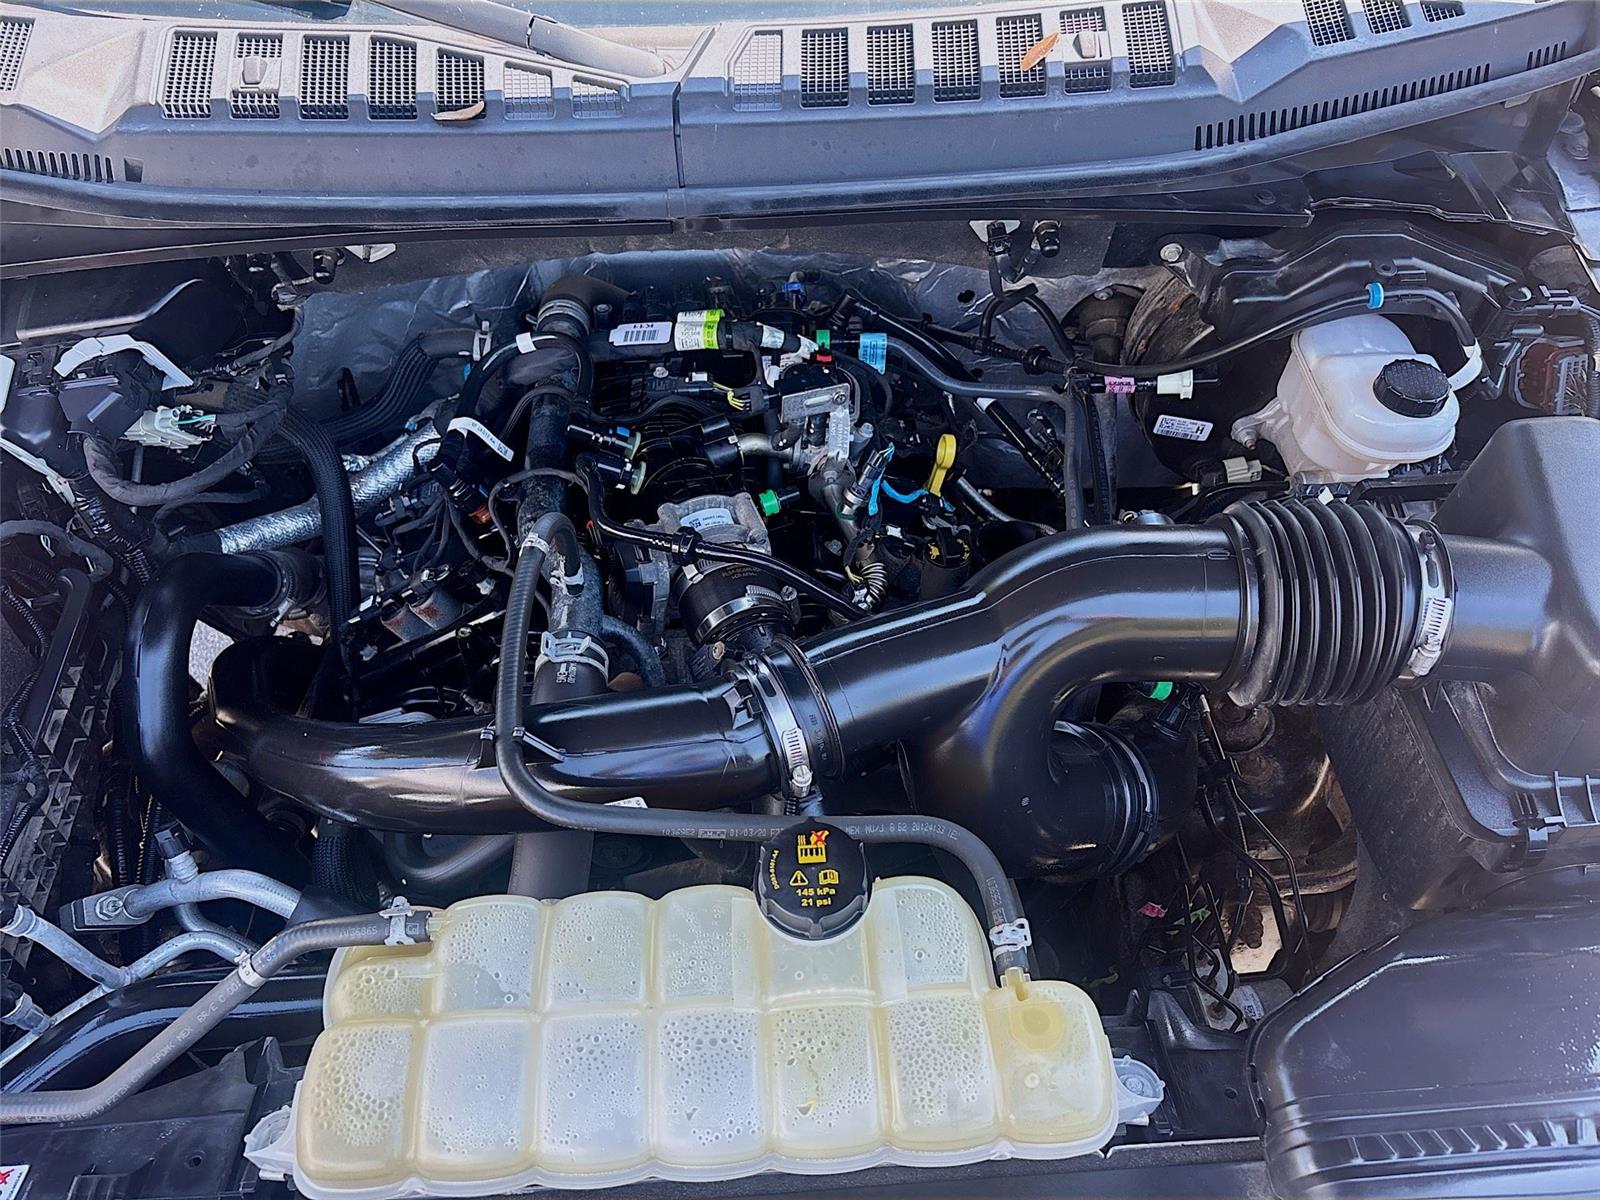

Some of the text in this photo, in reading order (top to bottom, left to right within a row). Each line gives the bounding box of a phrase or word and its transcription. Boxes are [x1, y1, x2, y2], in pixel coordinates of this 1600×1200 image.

[795, 887, 836, 896] 145 kPa
[801, 898, 831, 907] 21 psi
